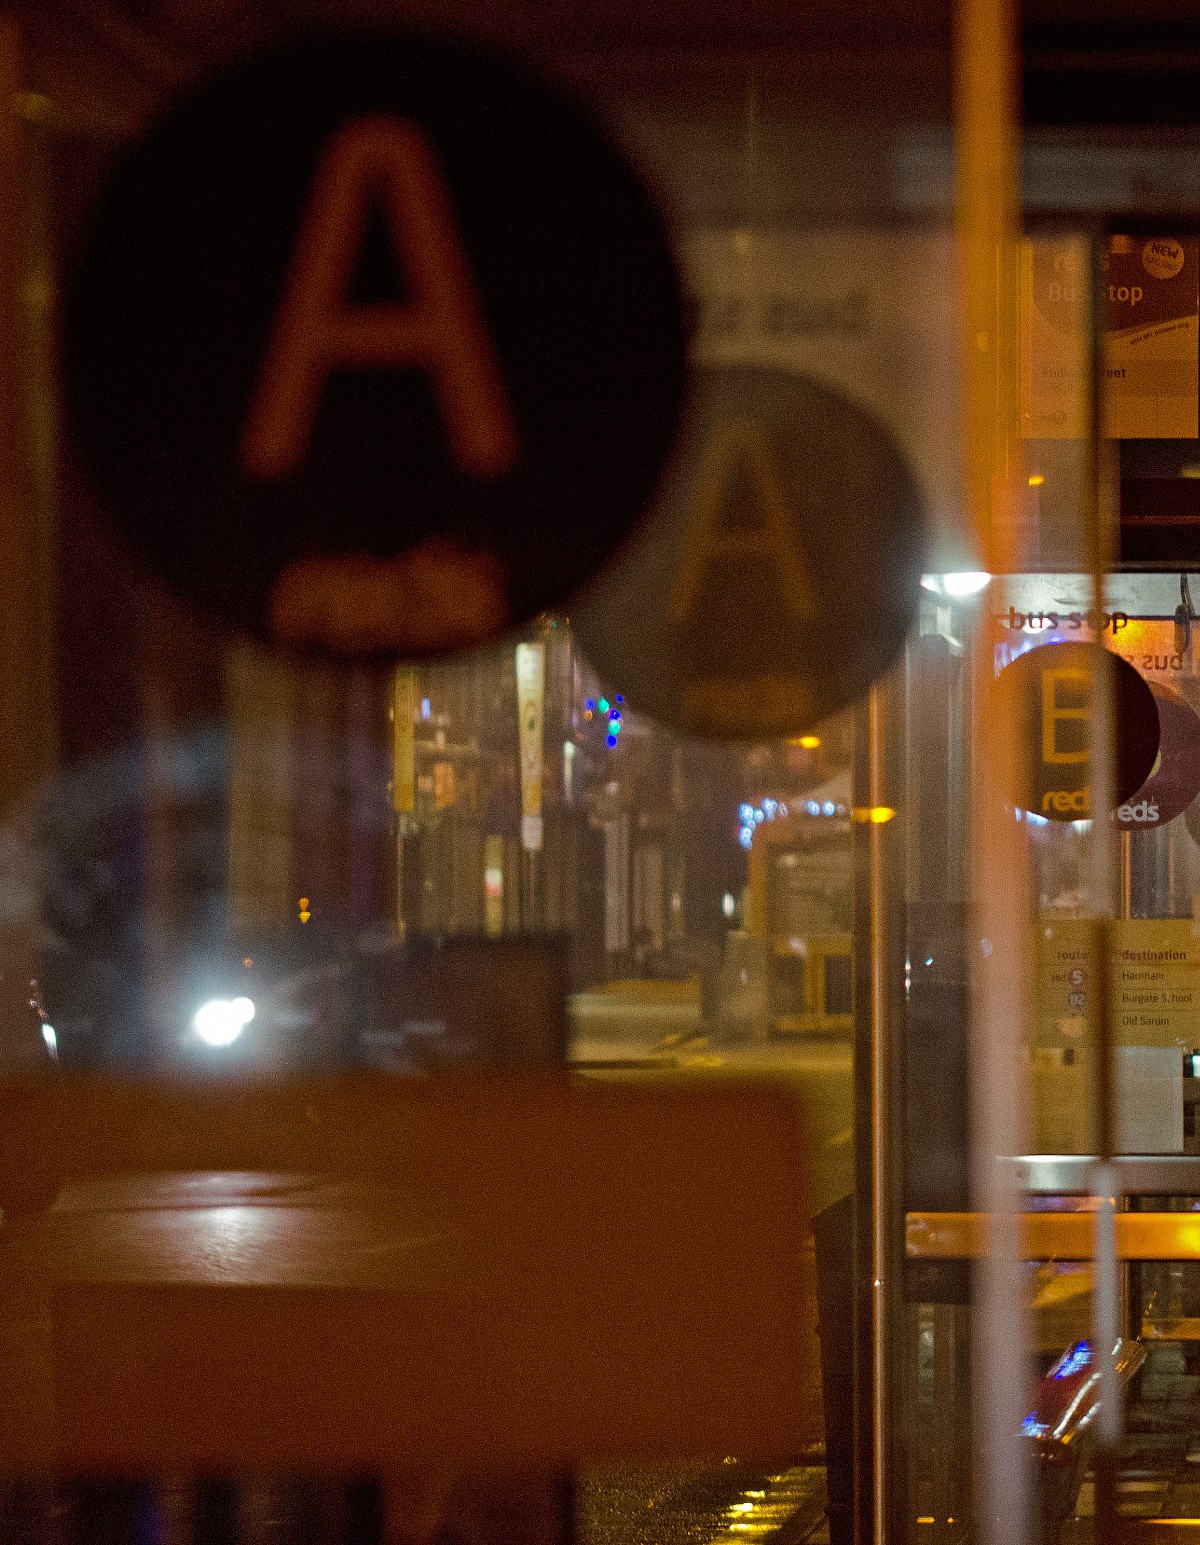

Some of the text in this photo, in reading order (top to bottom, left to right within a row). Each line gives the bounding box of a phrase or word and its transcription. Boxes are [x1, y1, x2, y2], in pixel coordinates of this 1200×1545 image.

[240, 112, 520, 482] A
[1106, 285, 1144, 306] top
[664, 422, 820, 622] A
[1009, 606, 1059, 630] bus
[1042, 785, 1092, 812] red
[1112, 800, 1160, 823] eds
[1121, 948, 1187, 961] destination
[1121, 1015, 1170, 1026] Old Sarum
